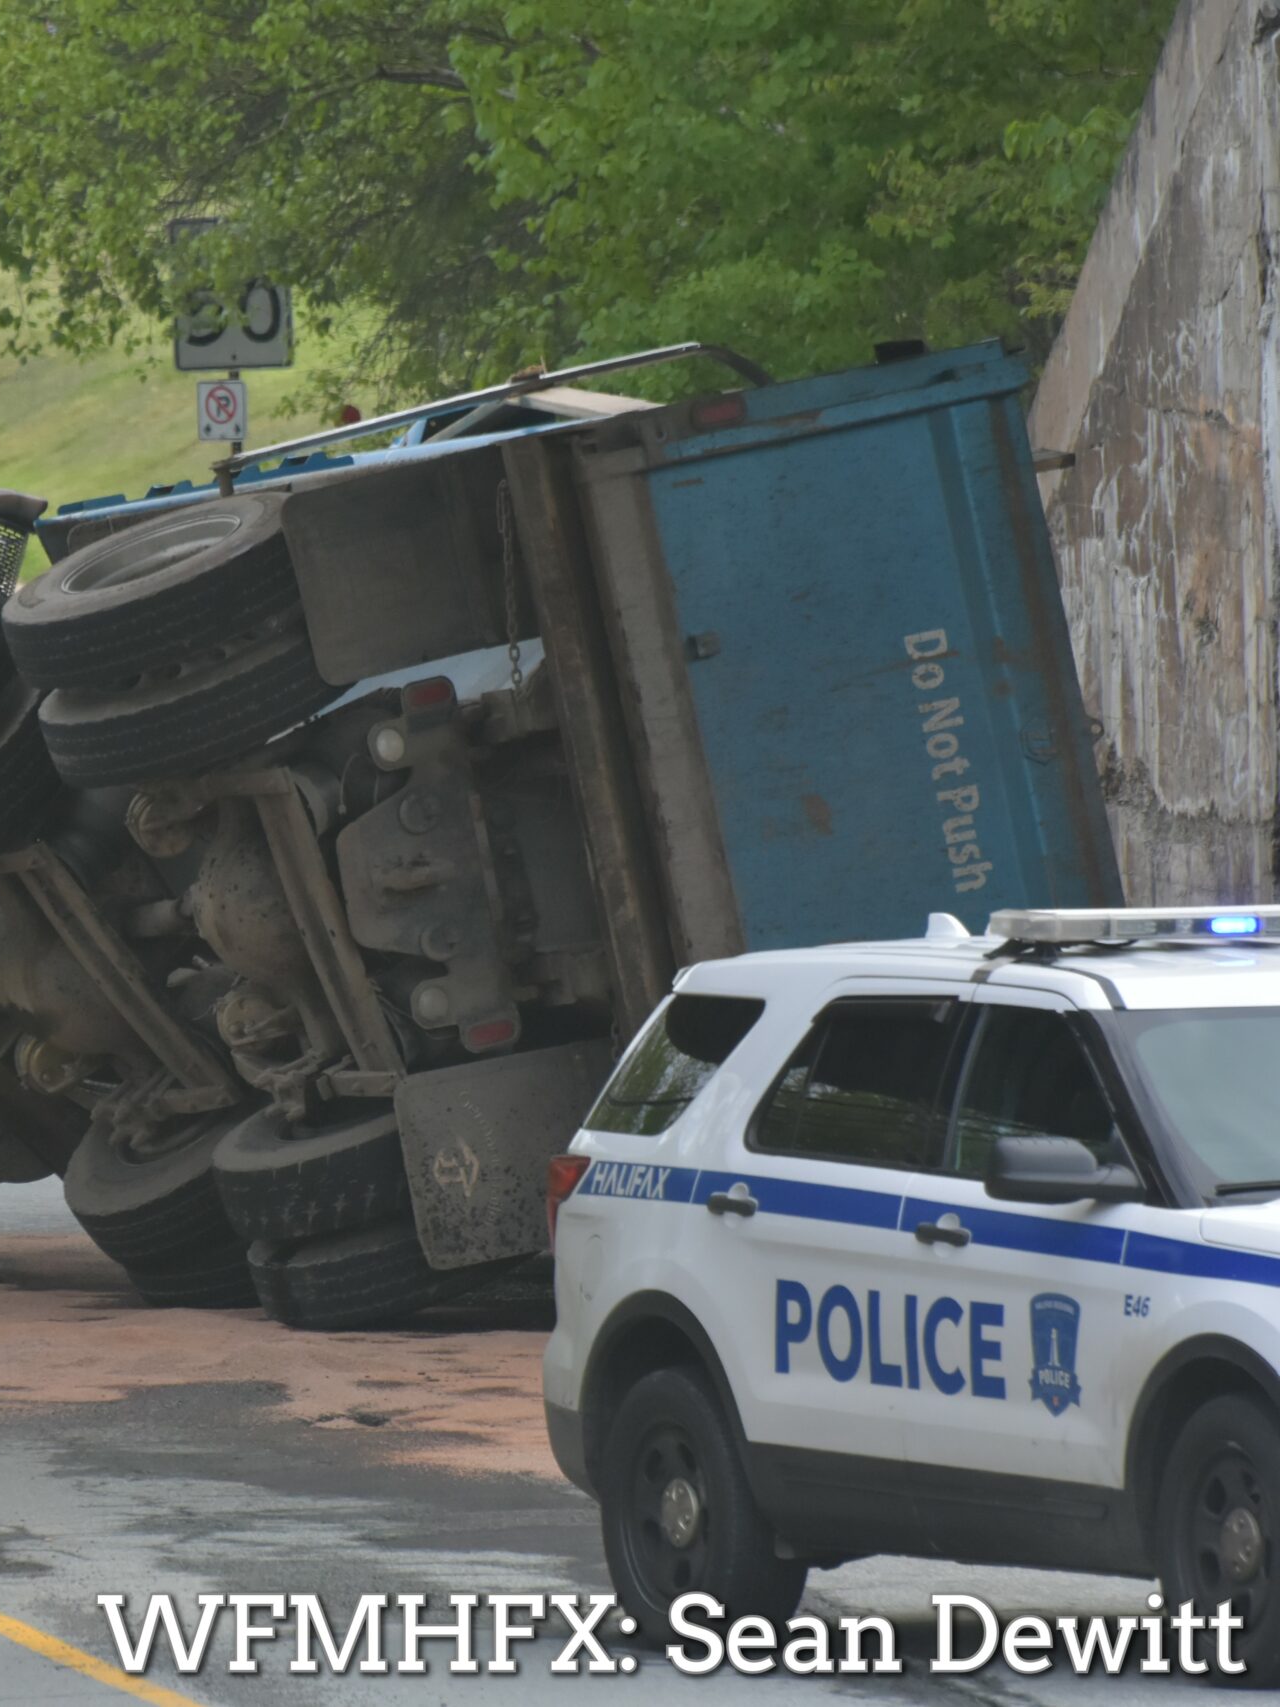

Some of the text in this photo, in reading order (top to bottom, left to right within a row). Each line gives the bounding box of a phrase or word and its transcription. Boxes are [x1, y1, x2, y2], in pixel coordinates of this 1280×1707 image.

[904, 628, 993, 893] Do Not Push
[591, 1162, 671, 1199] HALIFAX
[1124, 1294, 1151, 1318] E46
[775, 1278, 1007, 1400] POLICE
[1038, 1368, 1070, 1390] POLICE
